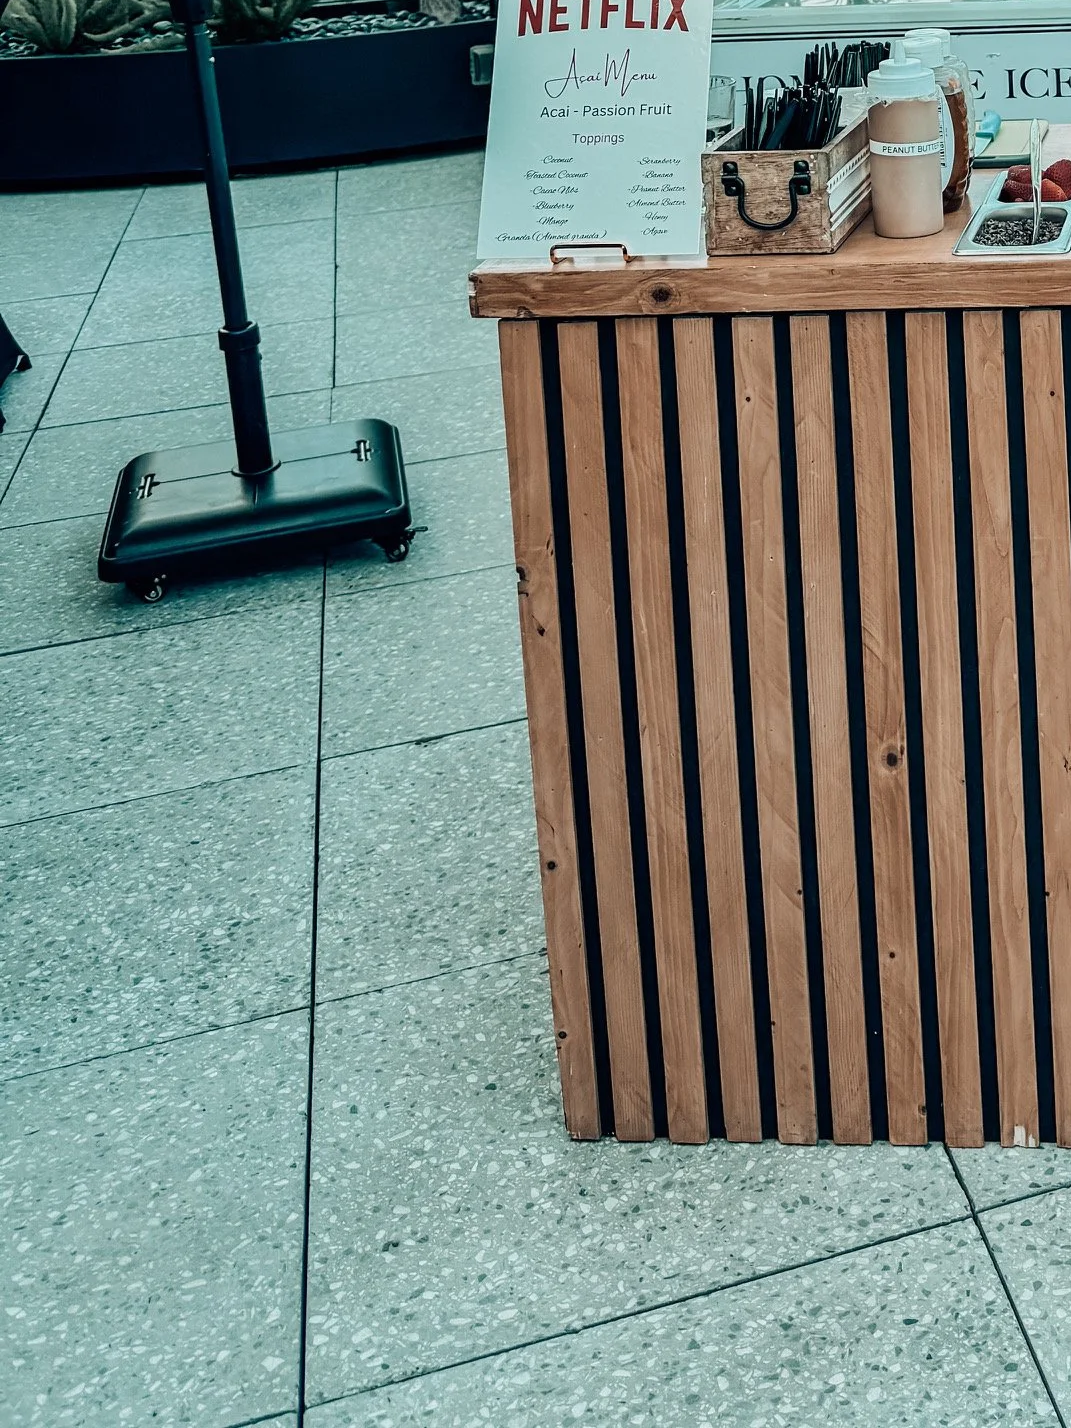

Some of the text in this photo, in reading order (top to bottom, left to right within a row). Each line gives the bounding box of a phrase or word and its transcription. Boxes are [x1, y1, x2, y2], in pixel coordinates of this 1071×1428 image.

[604, 48, 658, 97] Menu
[540, 105, 571, 118] Acai
[582, 104, 636, 118] Passion
[639, 103, 672, 116] Fruit
[572, 133, 625, 146] Toppings
[882, 145, 916, 154] PEANUT
